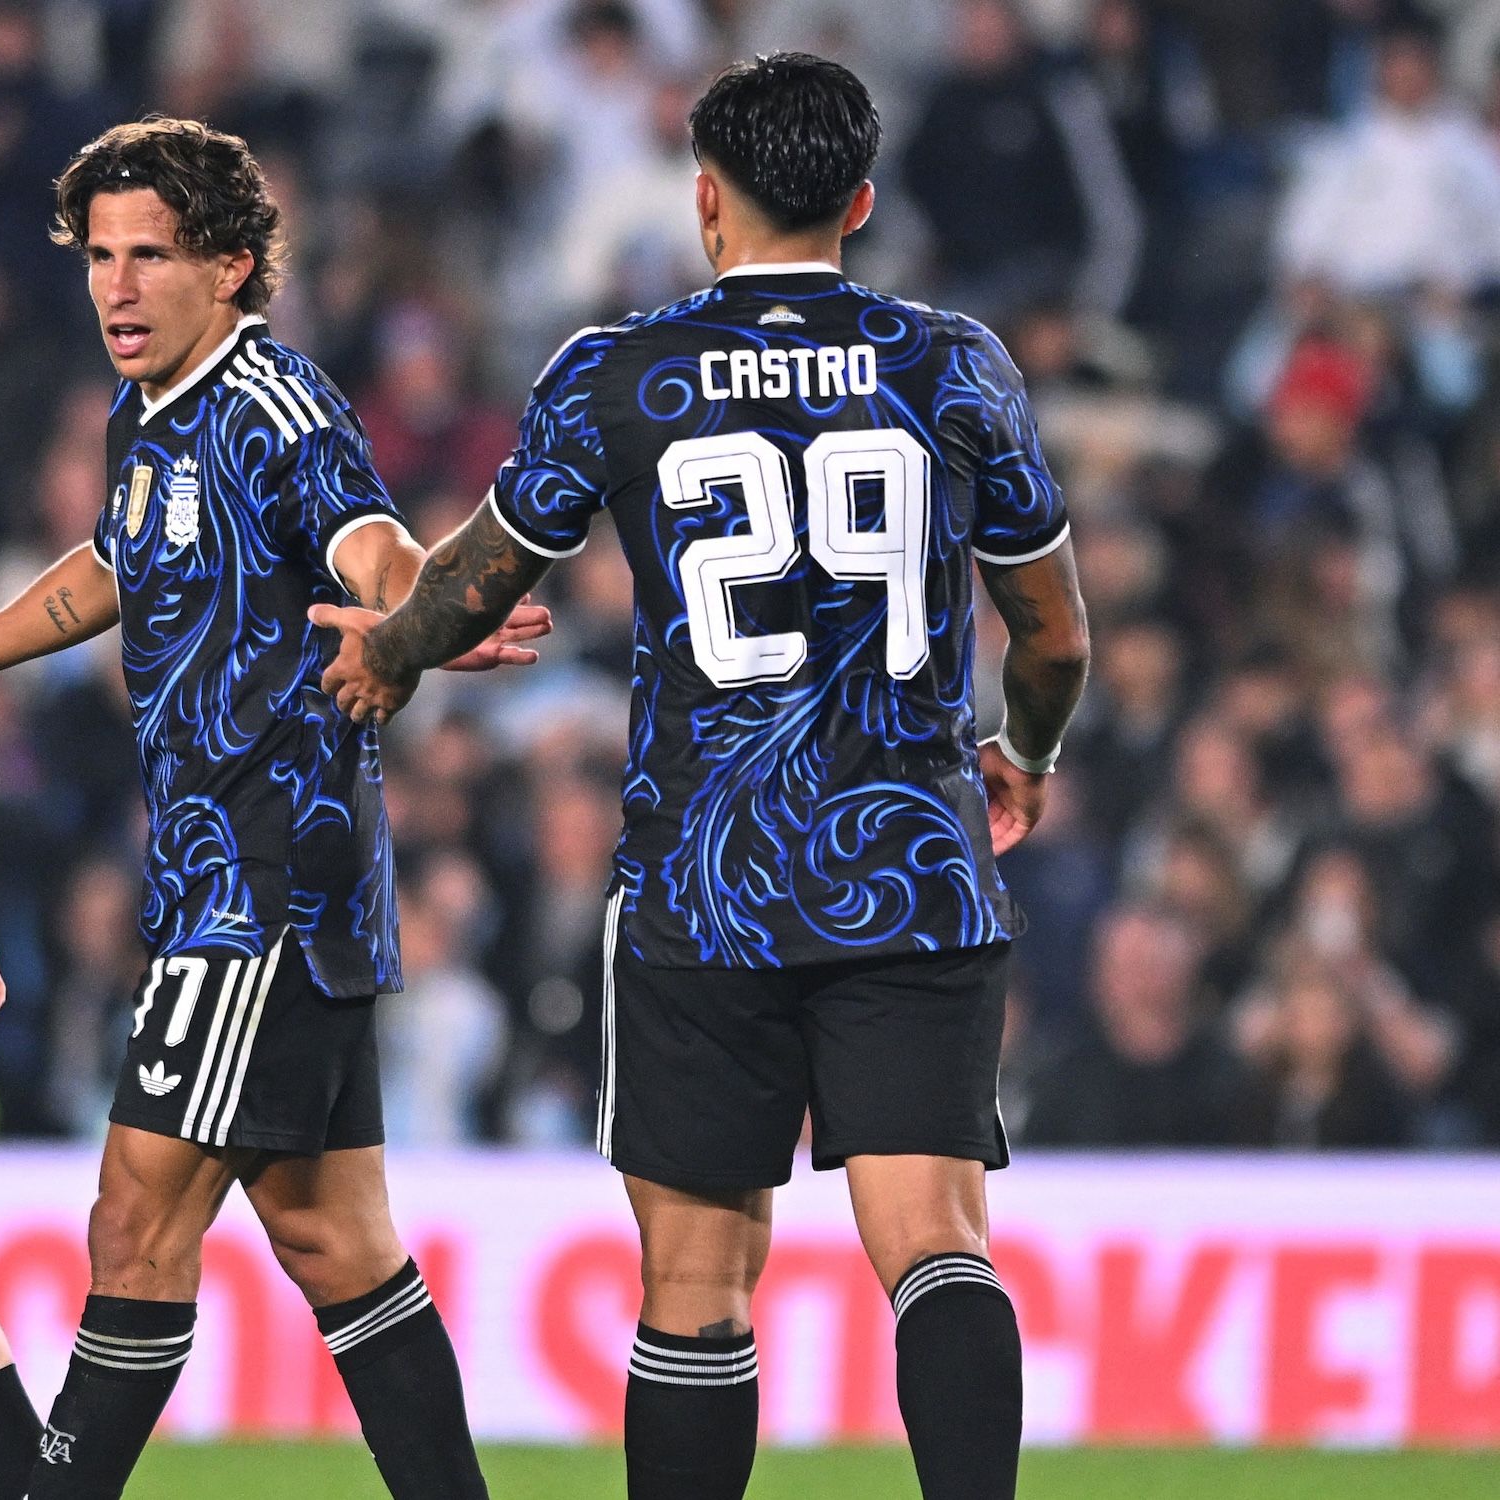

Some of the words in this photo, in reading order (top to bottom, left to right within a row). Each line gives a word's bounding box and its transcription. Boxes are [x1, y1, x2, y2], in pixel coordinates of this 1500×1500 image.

[699, 344, 878, 401] CASTRO
[657, 427, 931, 690] 29
[132, 956, 209, 1047] 17
[39, 1422, 77, 1465] AFA
